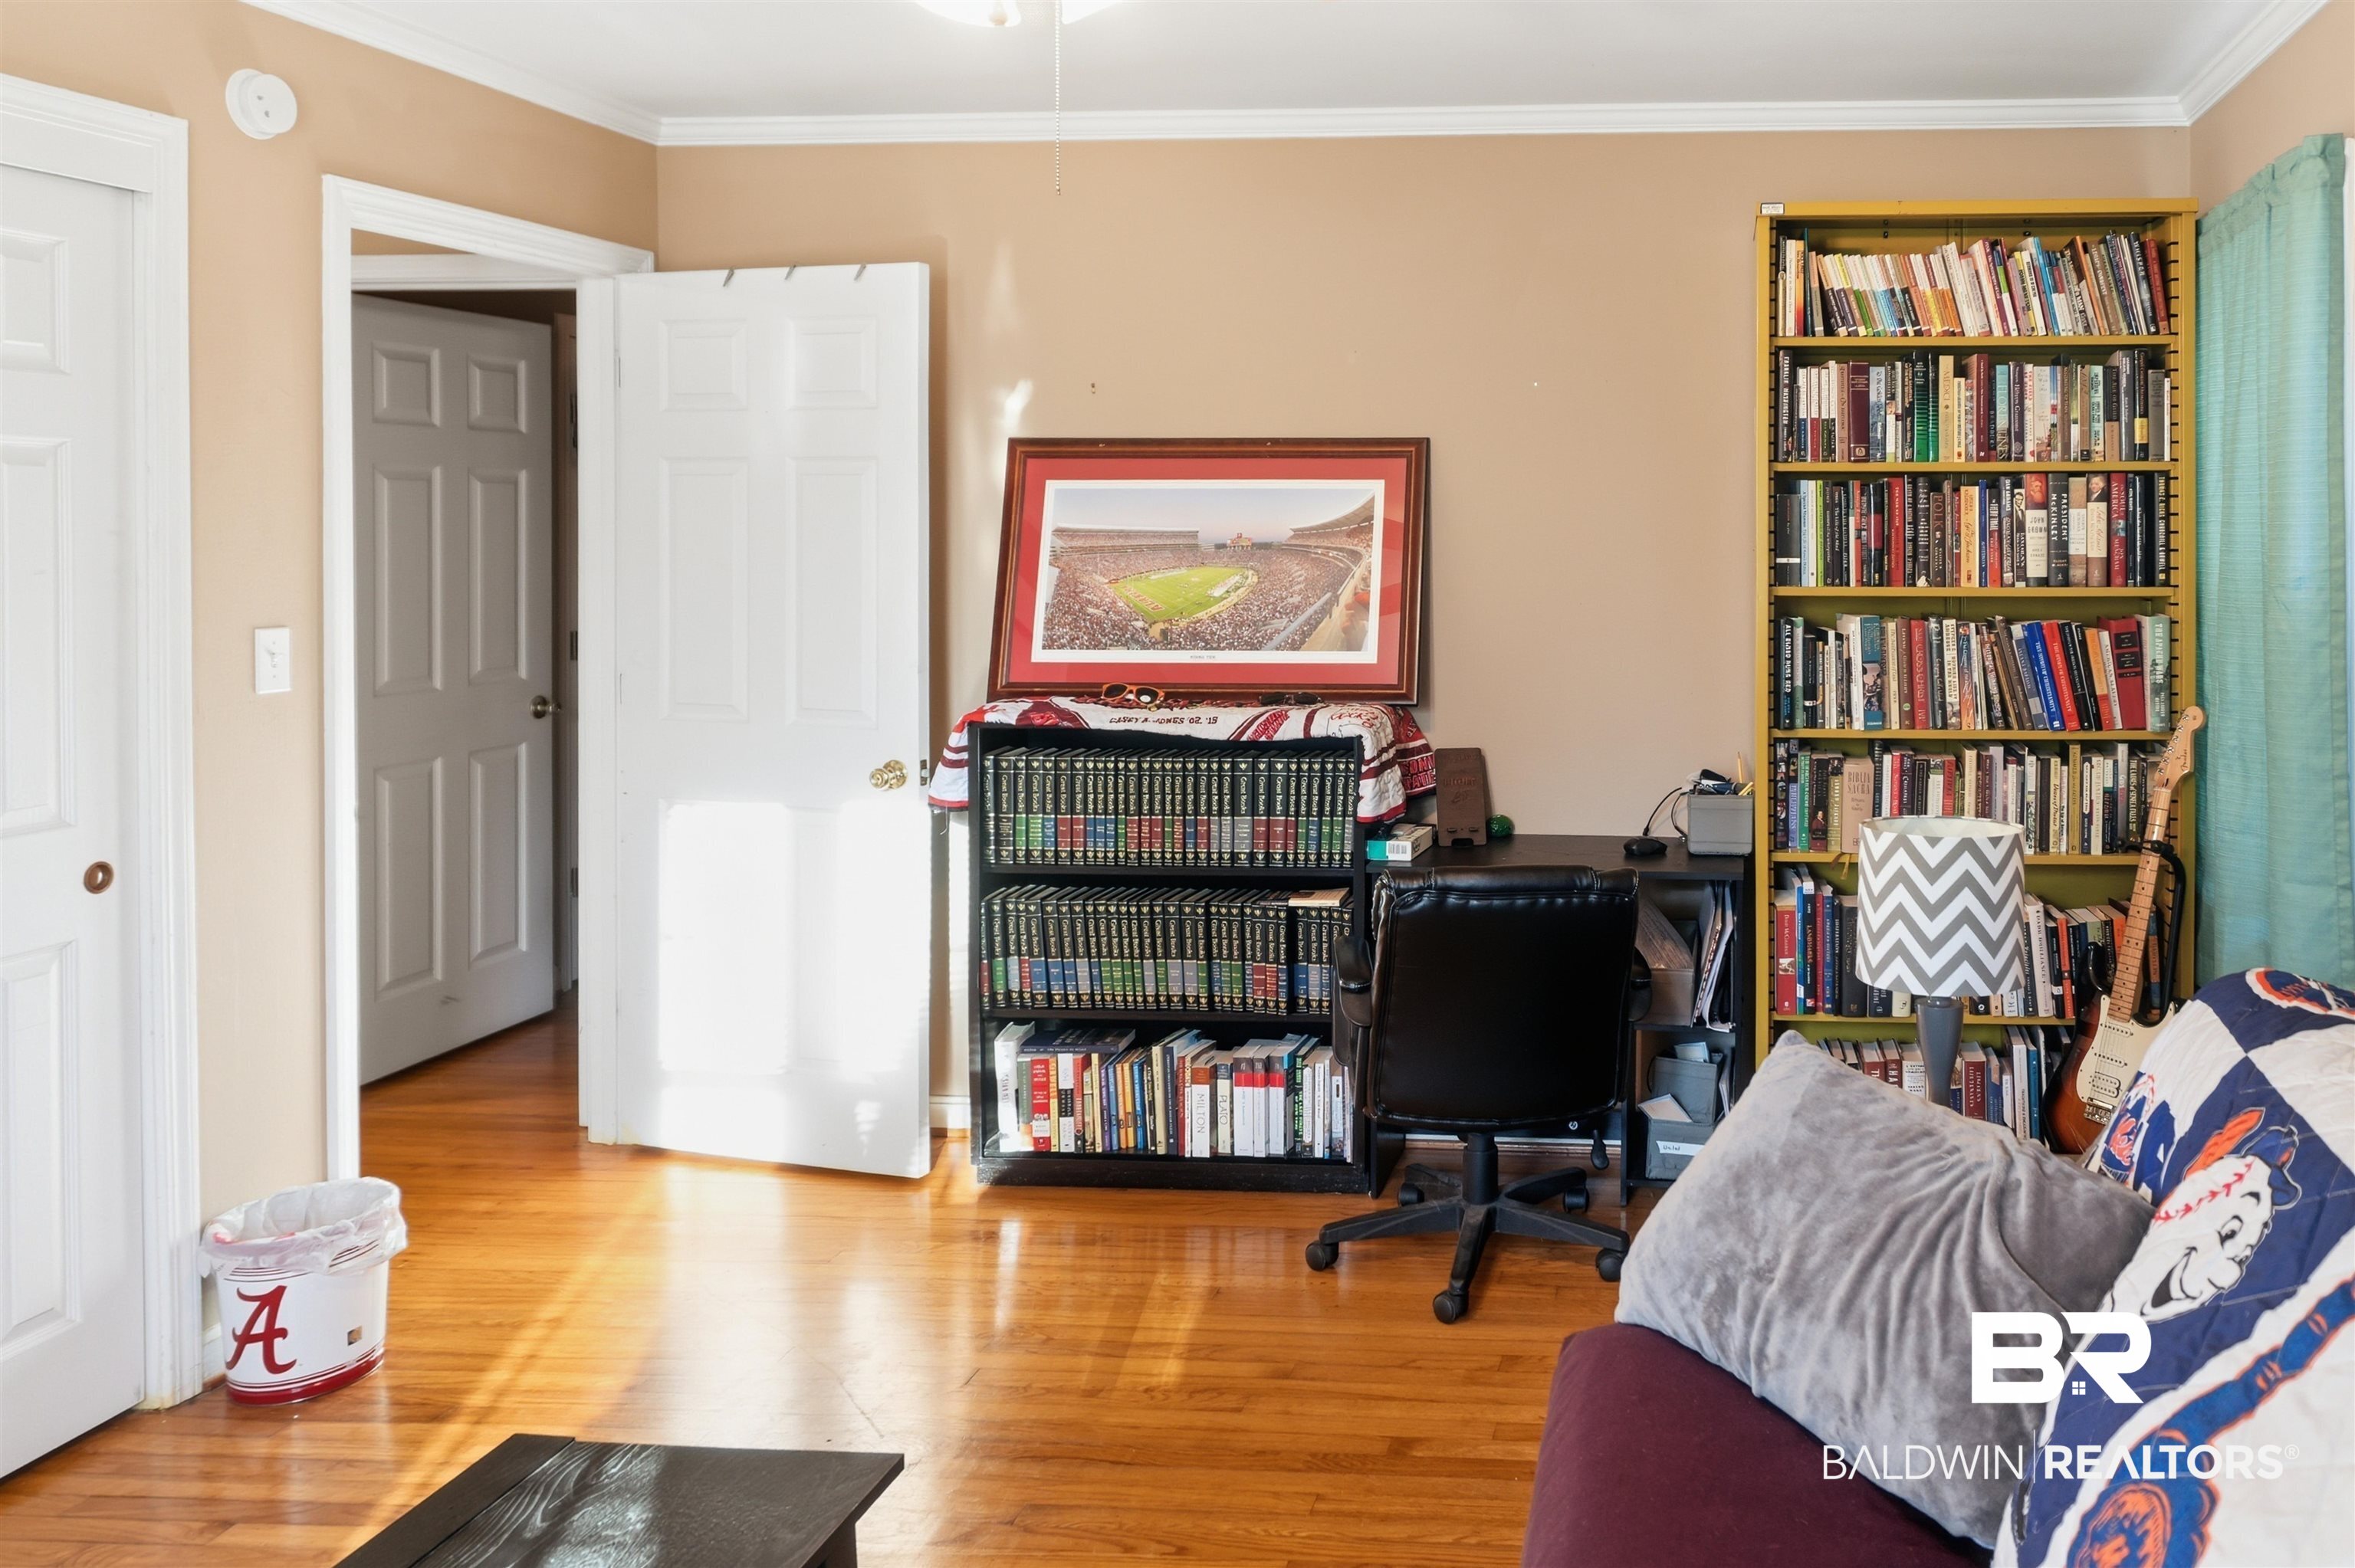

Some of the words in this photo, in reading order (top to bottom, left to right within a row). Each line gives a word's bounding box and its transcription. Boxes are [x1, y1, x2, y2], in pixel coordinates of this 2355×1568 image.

[1933, 495, 1943, 528] POLK
[1916, 644, 1924, 672] CROSS
[2155, 638, 2163, 664] APACHE
[2155, 665, 2163, 684] WARS
[1017, 774, 1026, 791] Great
[1075, 776, 1083, 792] Great
[1141, 776, 1150, 793] Great
[1848, 772, 1871, 783] BIBLIA
[1848, 784, 1871, 795] SACRA
[1017, 792, 1026, 812] Books
[1032, 793, 1040, 812] Books
[1045, 794, 1053, 812] Books
[1075, 793, 1083, 812] Books
[1197, 940, 1206, 959] Books
[1196, 1093, 1205, 1133] MILTON
[1219, 1095, 1227, 1125] PLATO
[225, 1284, 297, 1374] A
